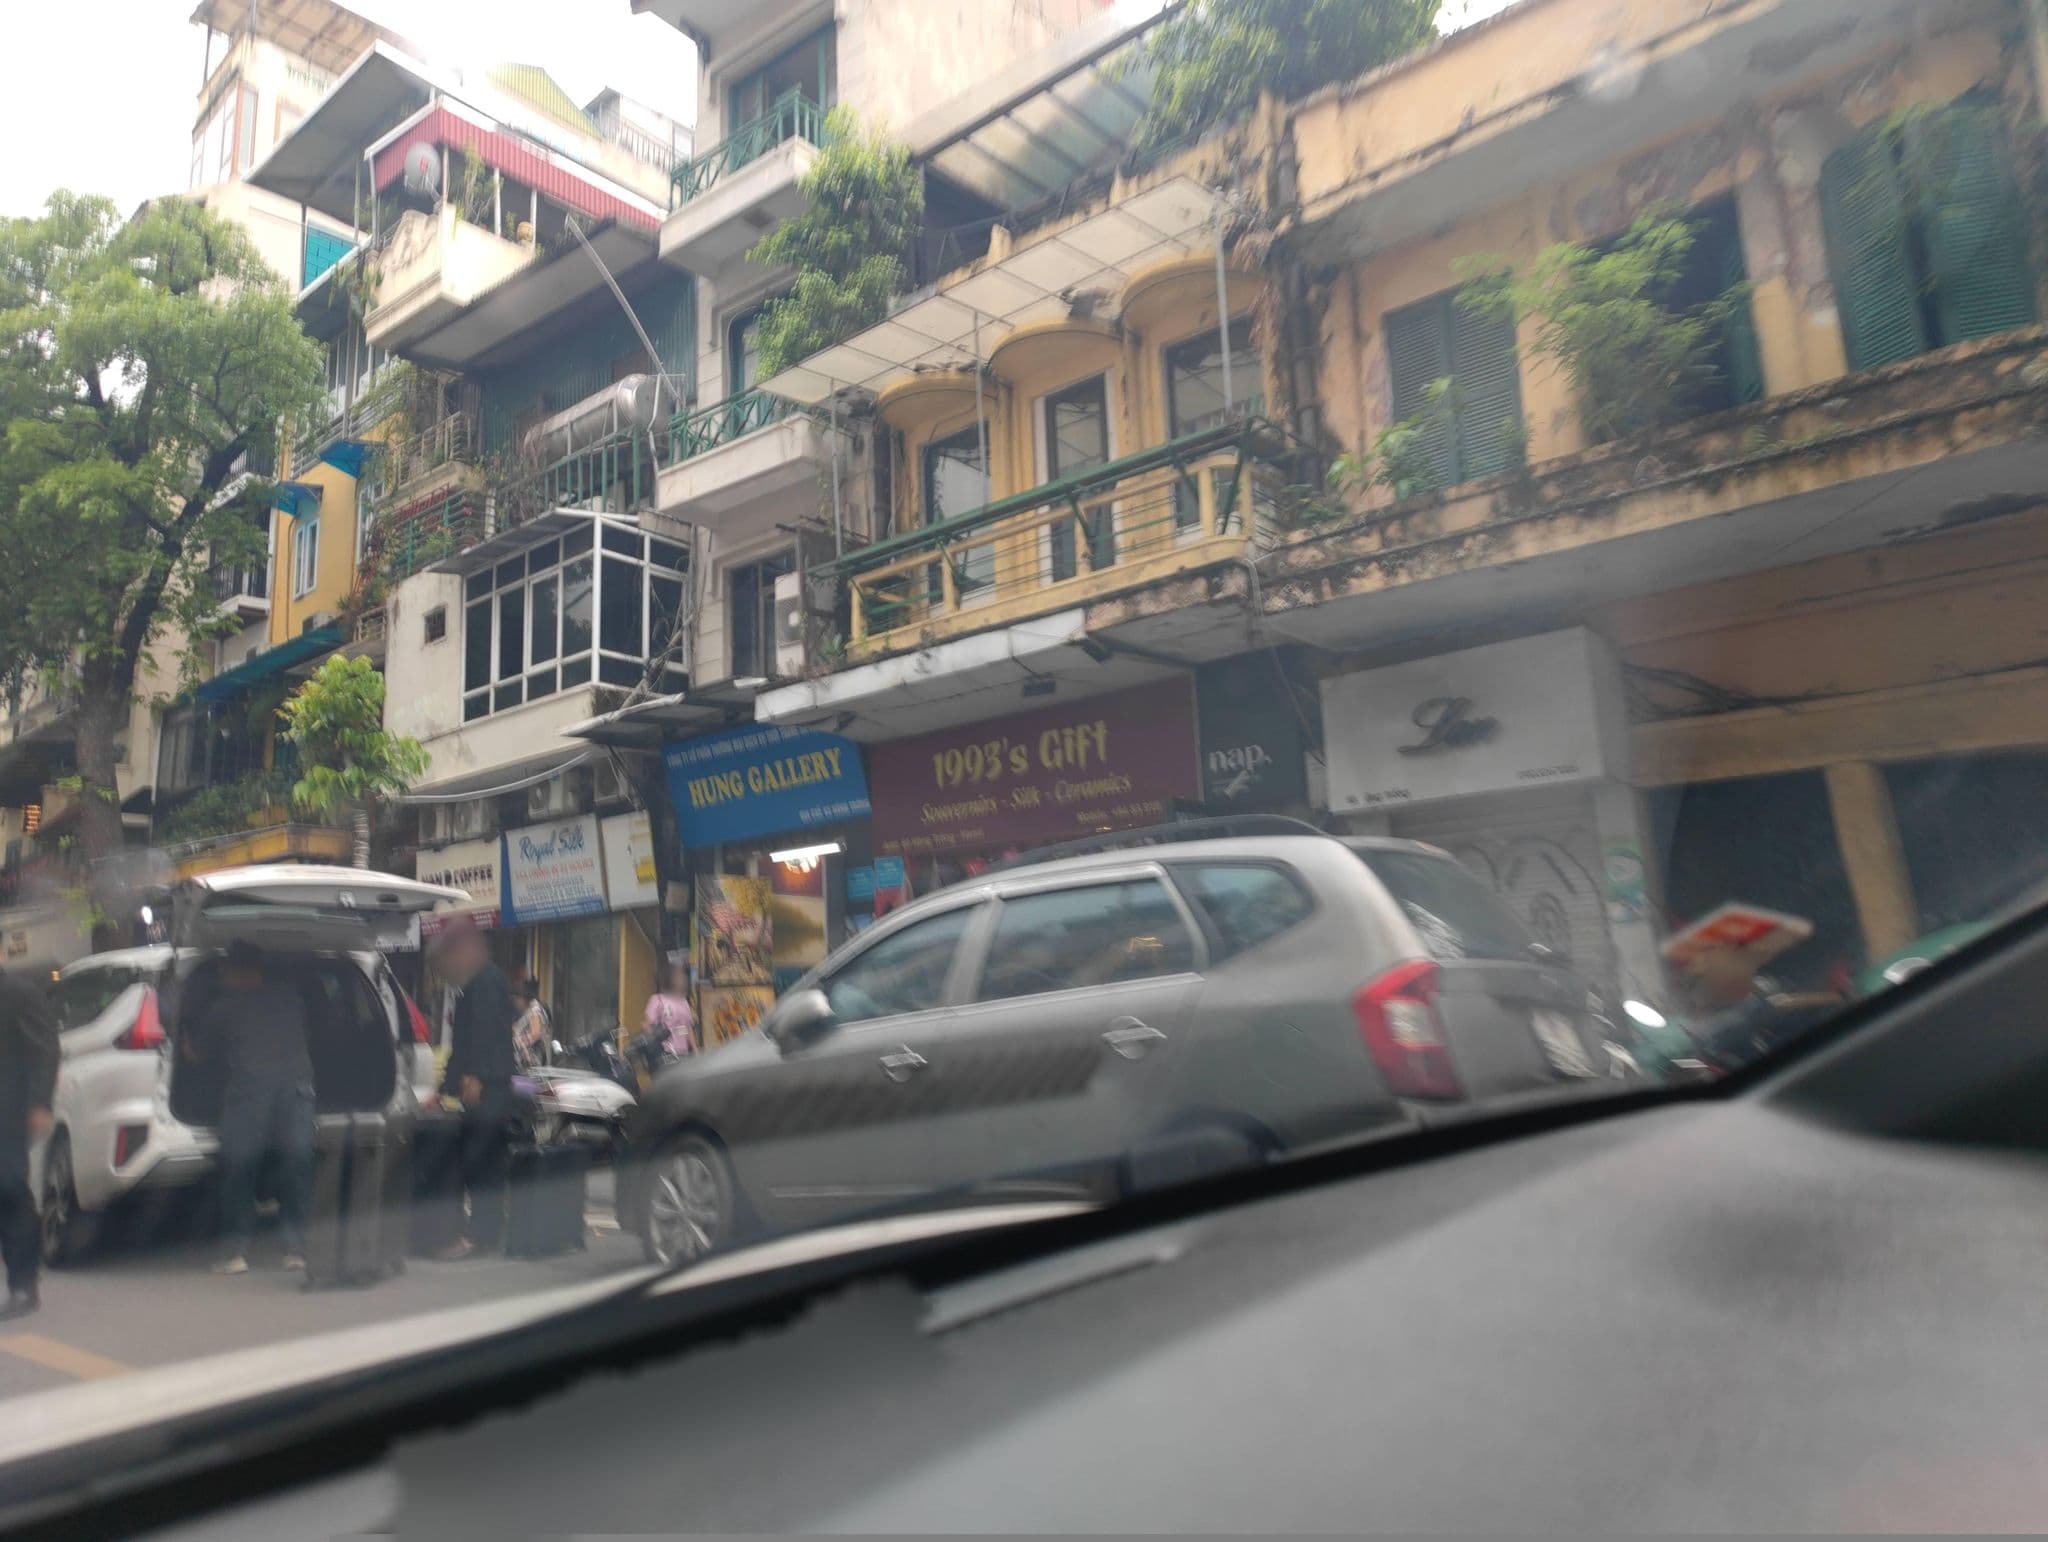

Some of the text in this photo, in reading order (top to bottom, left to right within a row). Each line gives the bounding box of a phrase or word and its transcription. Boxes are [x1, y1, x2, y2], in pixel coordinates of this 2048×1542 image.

[688, 770, 745, 809] HUNG
[748, 747, 842, 795] GALLERY
[933, 737, 1030, 789] 1993's
